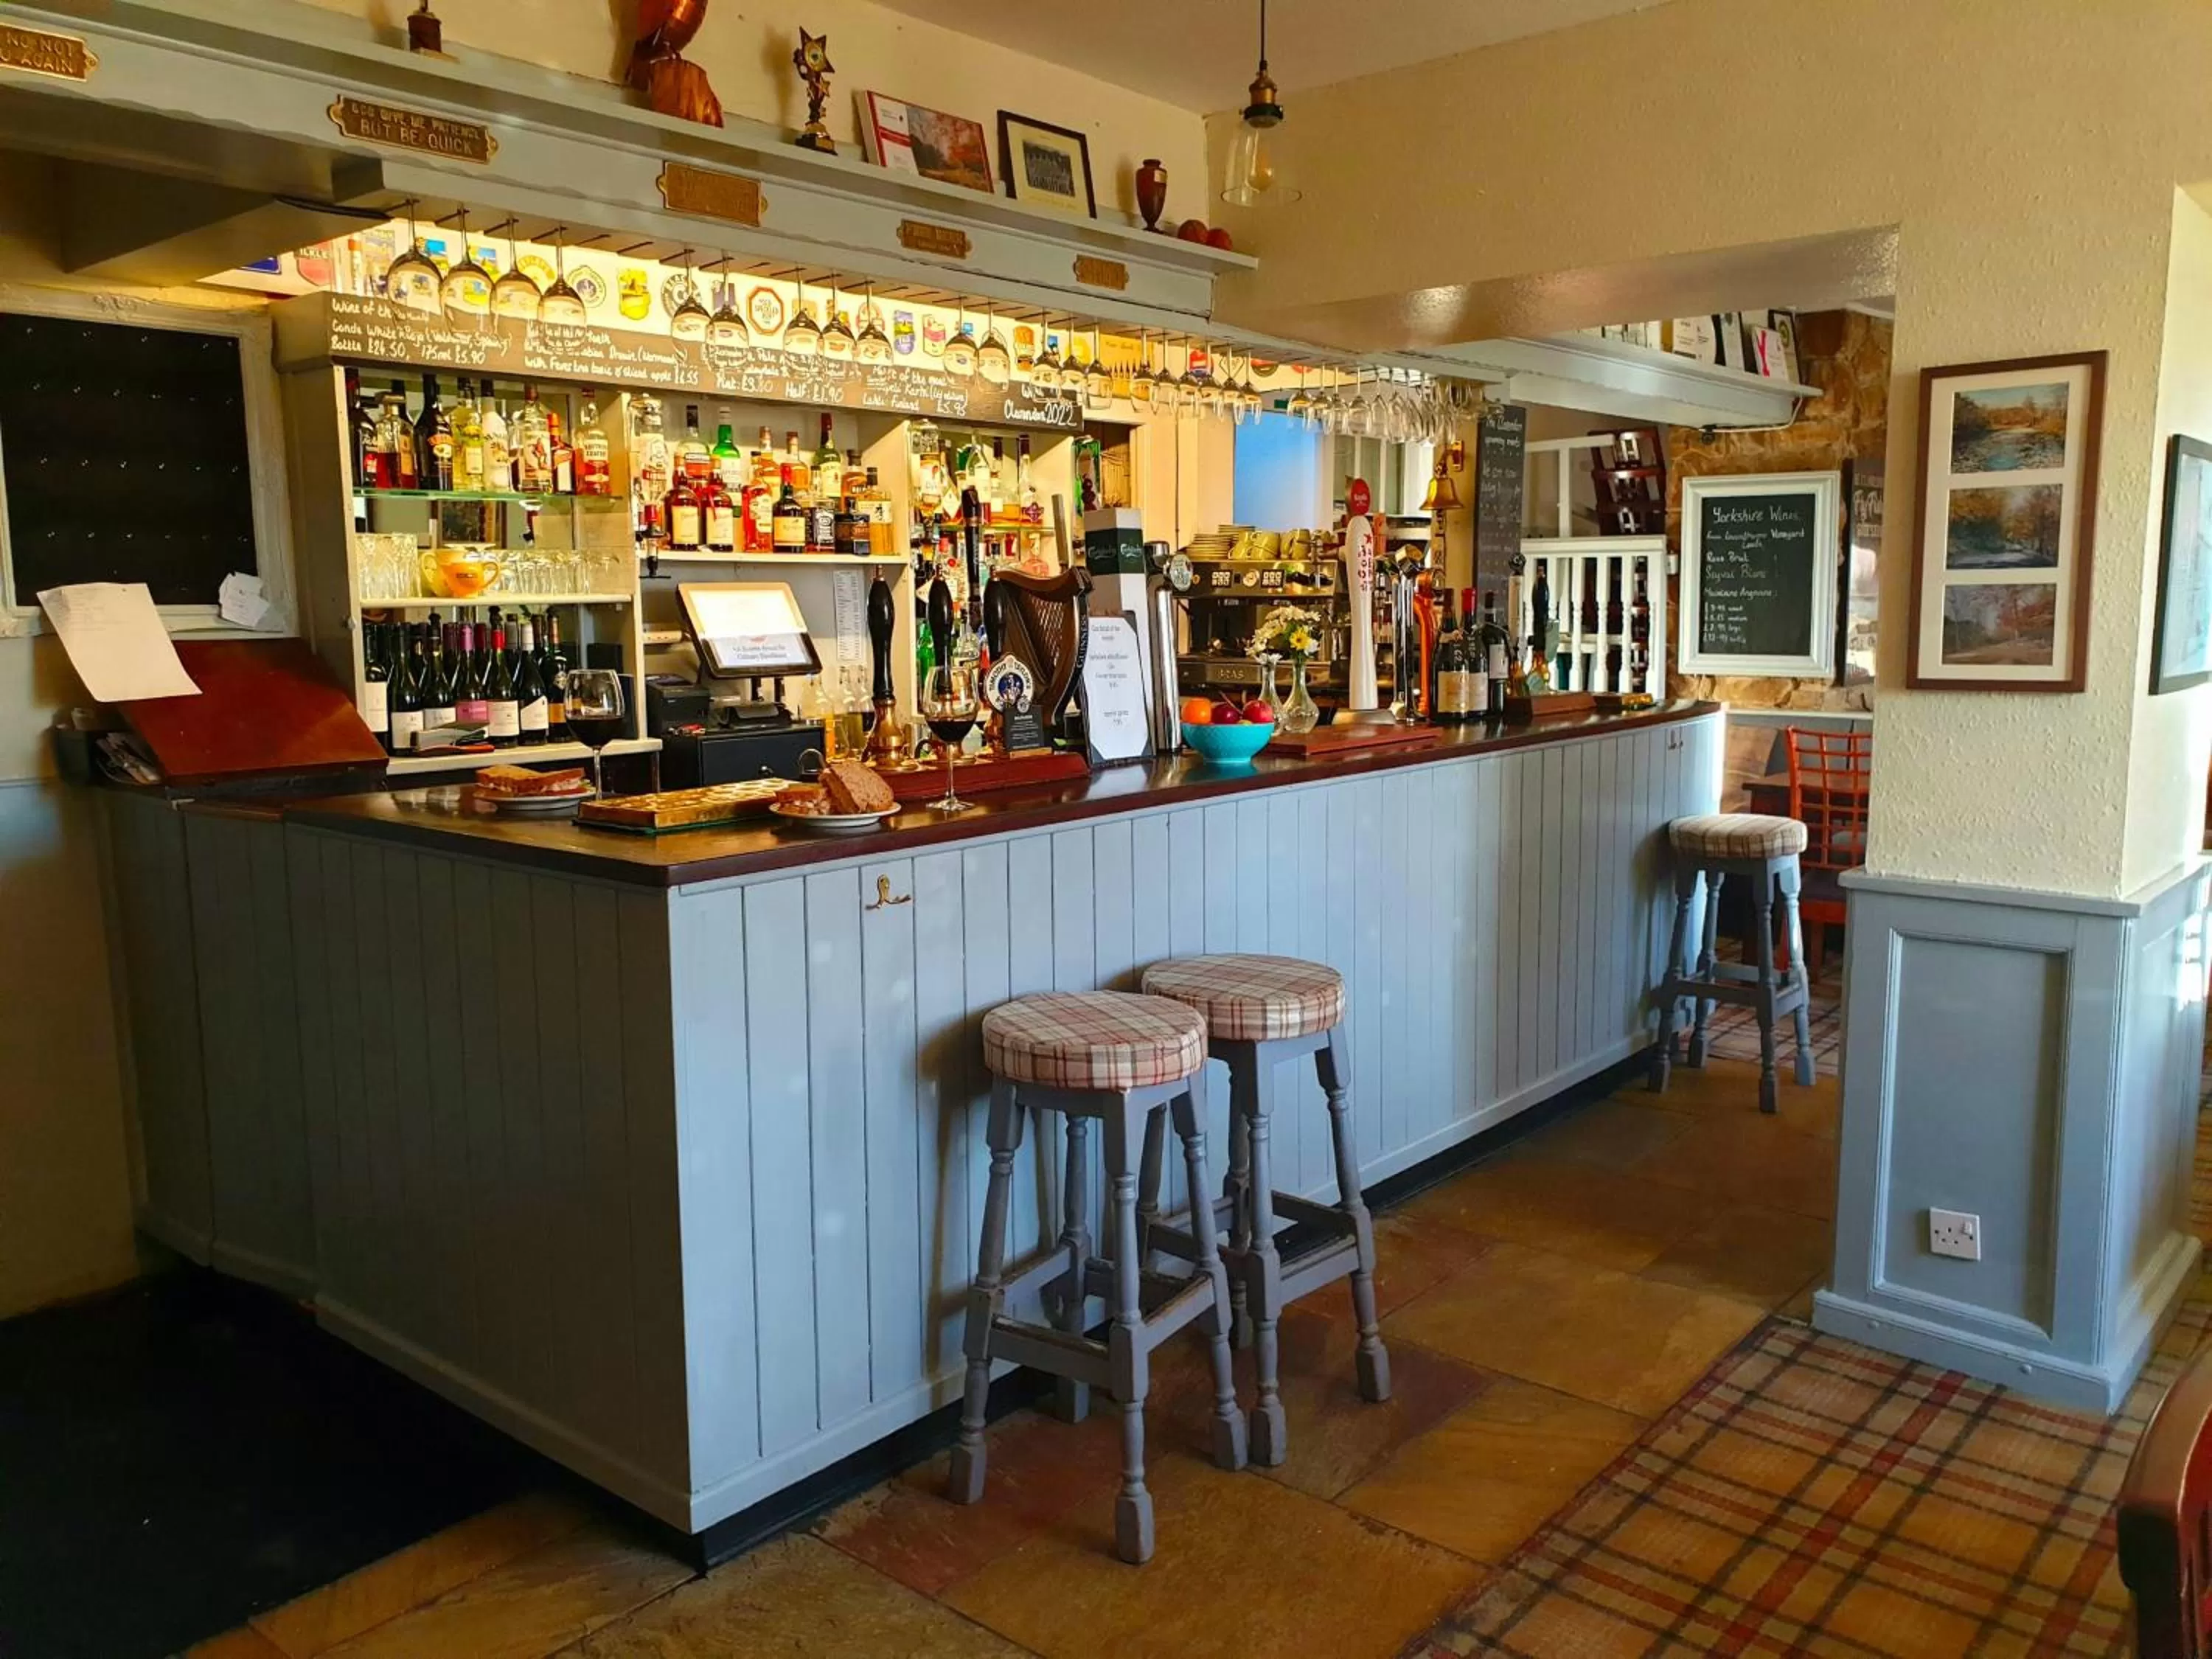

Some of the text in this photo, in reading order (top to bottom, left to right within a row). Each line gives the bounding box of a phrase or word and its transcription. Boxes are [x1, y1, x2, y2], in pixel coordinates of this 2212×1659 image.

[40, 35, 72, 58] NOT
[21, 49, 74, 74] AGAIN
[361, 118, 473, 155] BUT BE QUICK
[333, 298, 361, 314] Wine
[363, 303, 375, 317] of
[1713, 507, 1764, 524] Yorkshire
